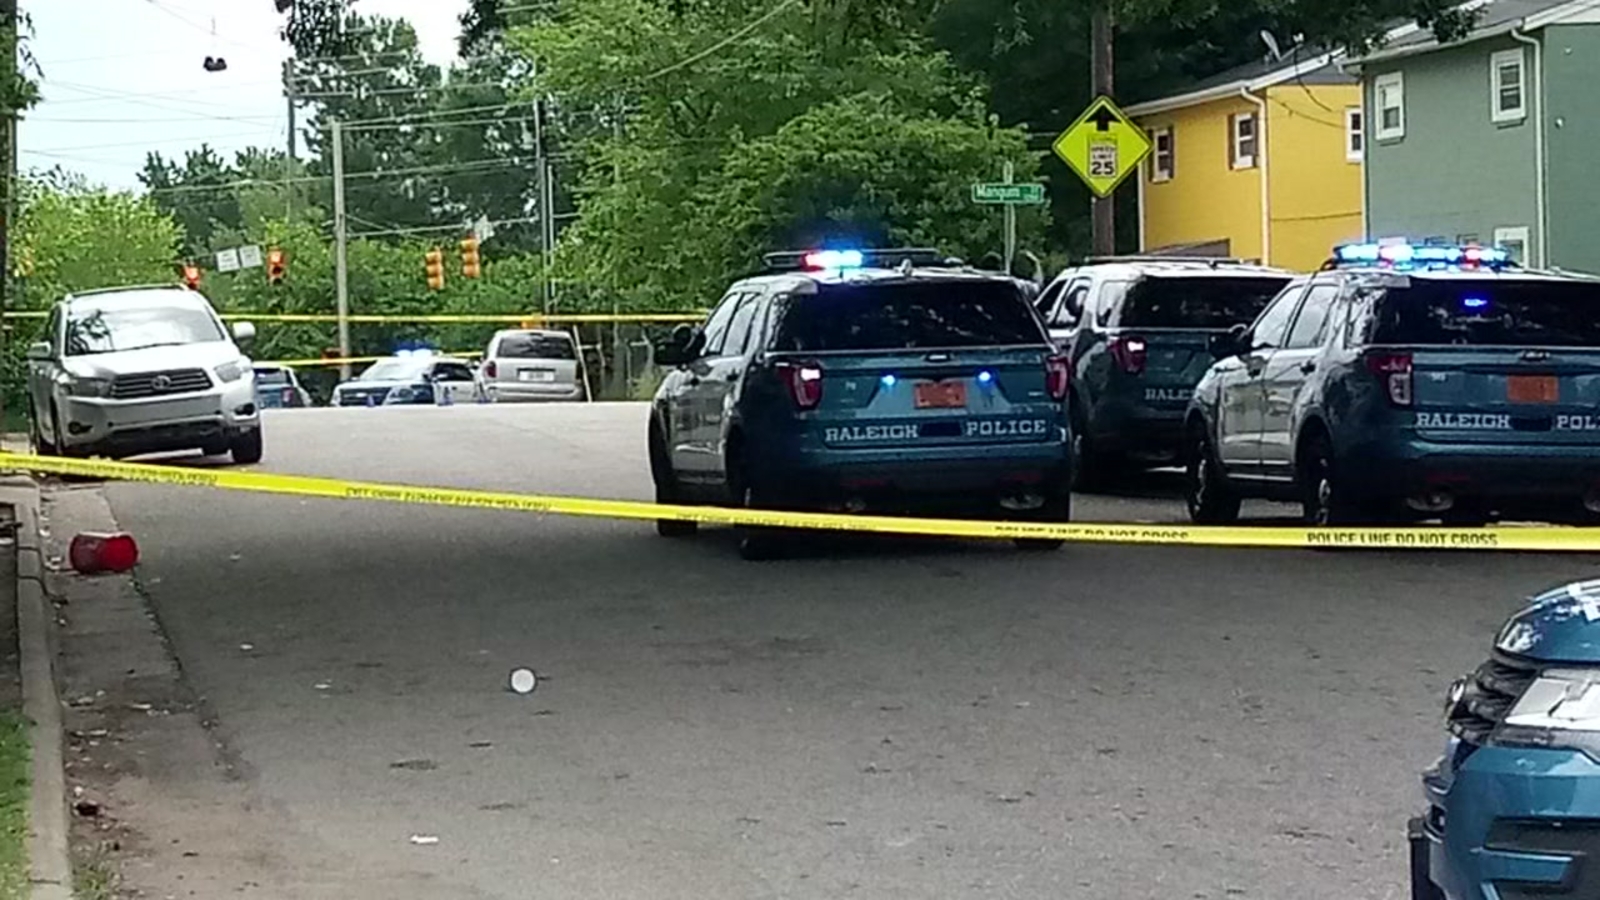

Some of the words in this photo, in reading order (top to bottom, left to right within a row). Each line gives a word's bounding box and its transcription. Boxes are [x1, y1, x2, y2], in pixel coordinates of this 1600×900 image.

[1091, 161, 1114, 175] 25
[976, 184, 1020, 201] Mangum
[1415, 412, 1511, 429] RALEIGH
[824, 424, 919, 442] RALEIGH
[966, 419, 1046, 436] POLICE
[1307, 532, 1356, 543] POLICE
[1361, 532, 1391, 544] LINE
[1395, 533, 1415, 544] DO
[1419, 533, 1447, 545] NOT
[1451, 533, 1498, 546] CROSS
